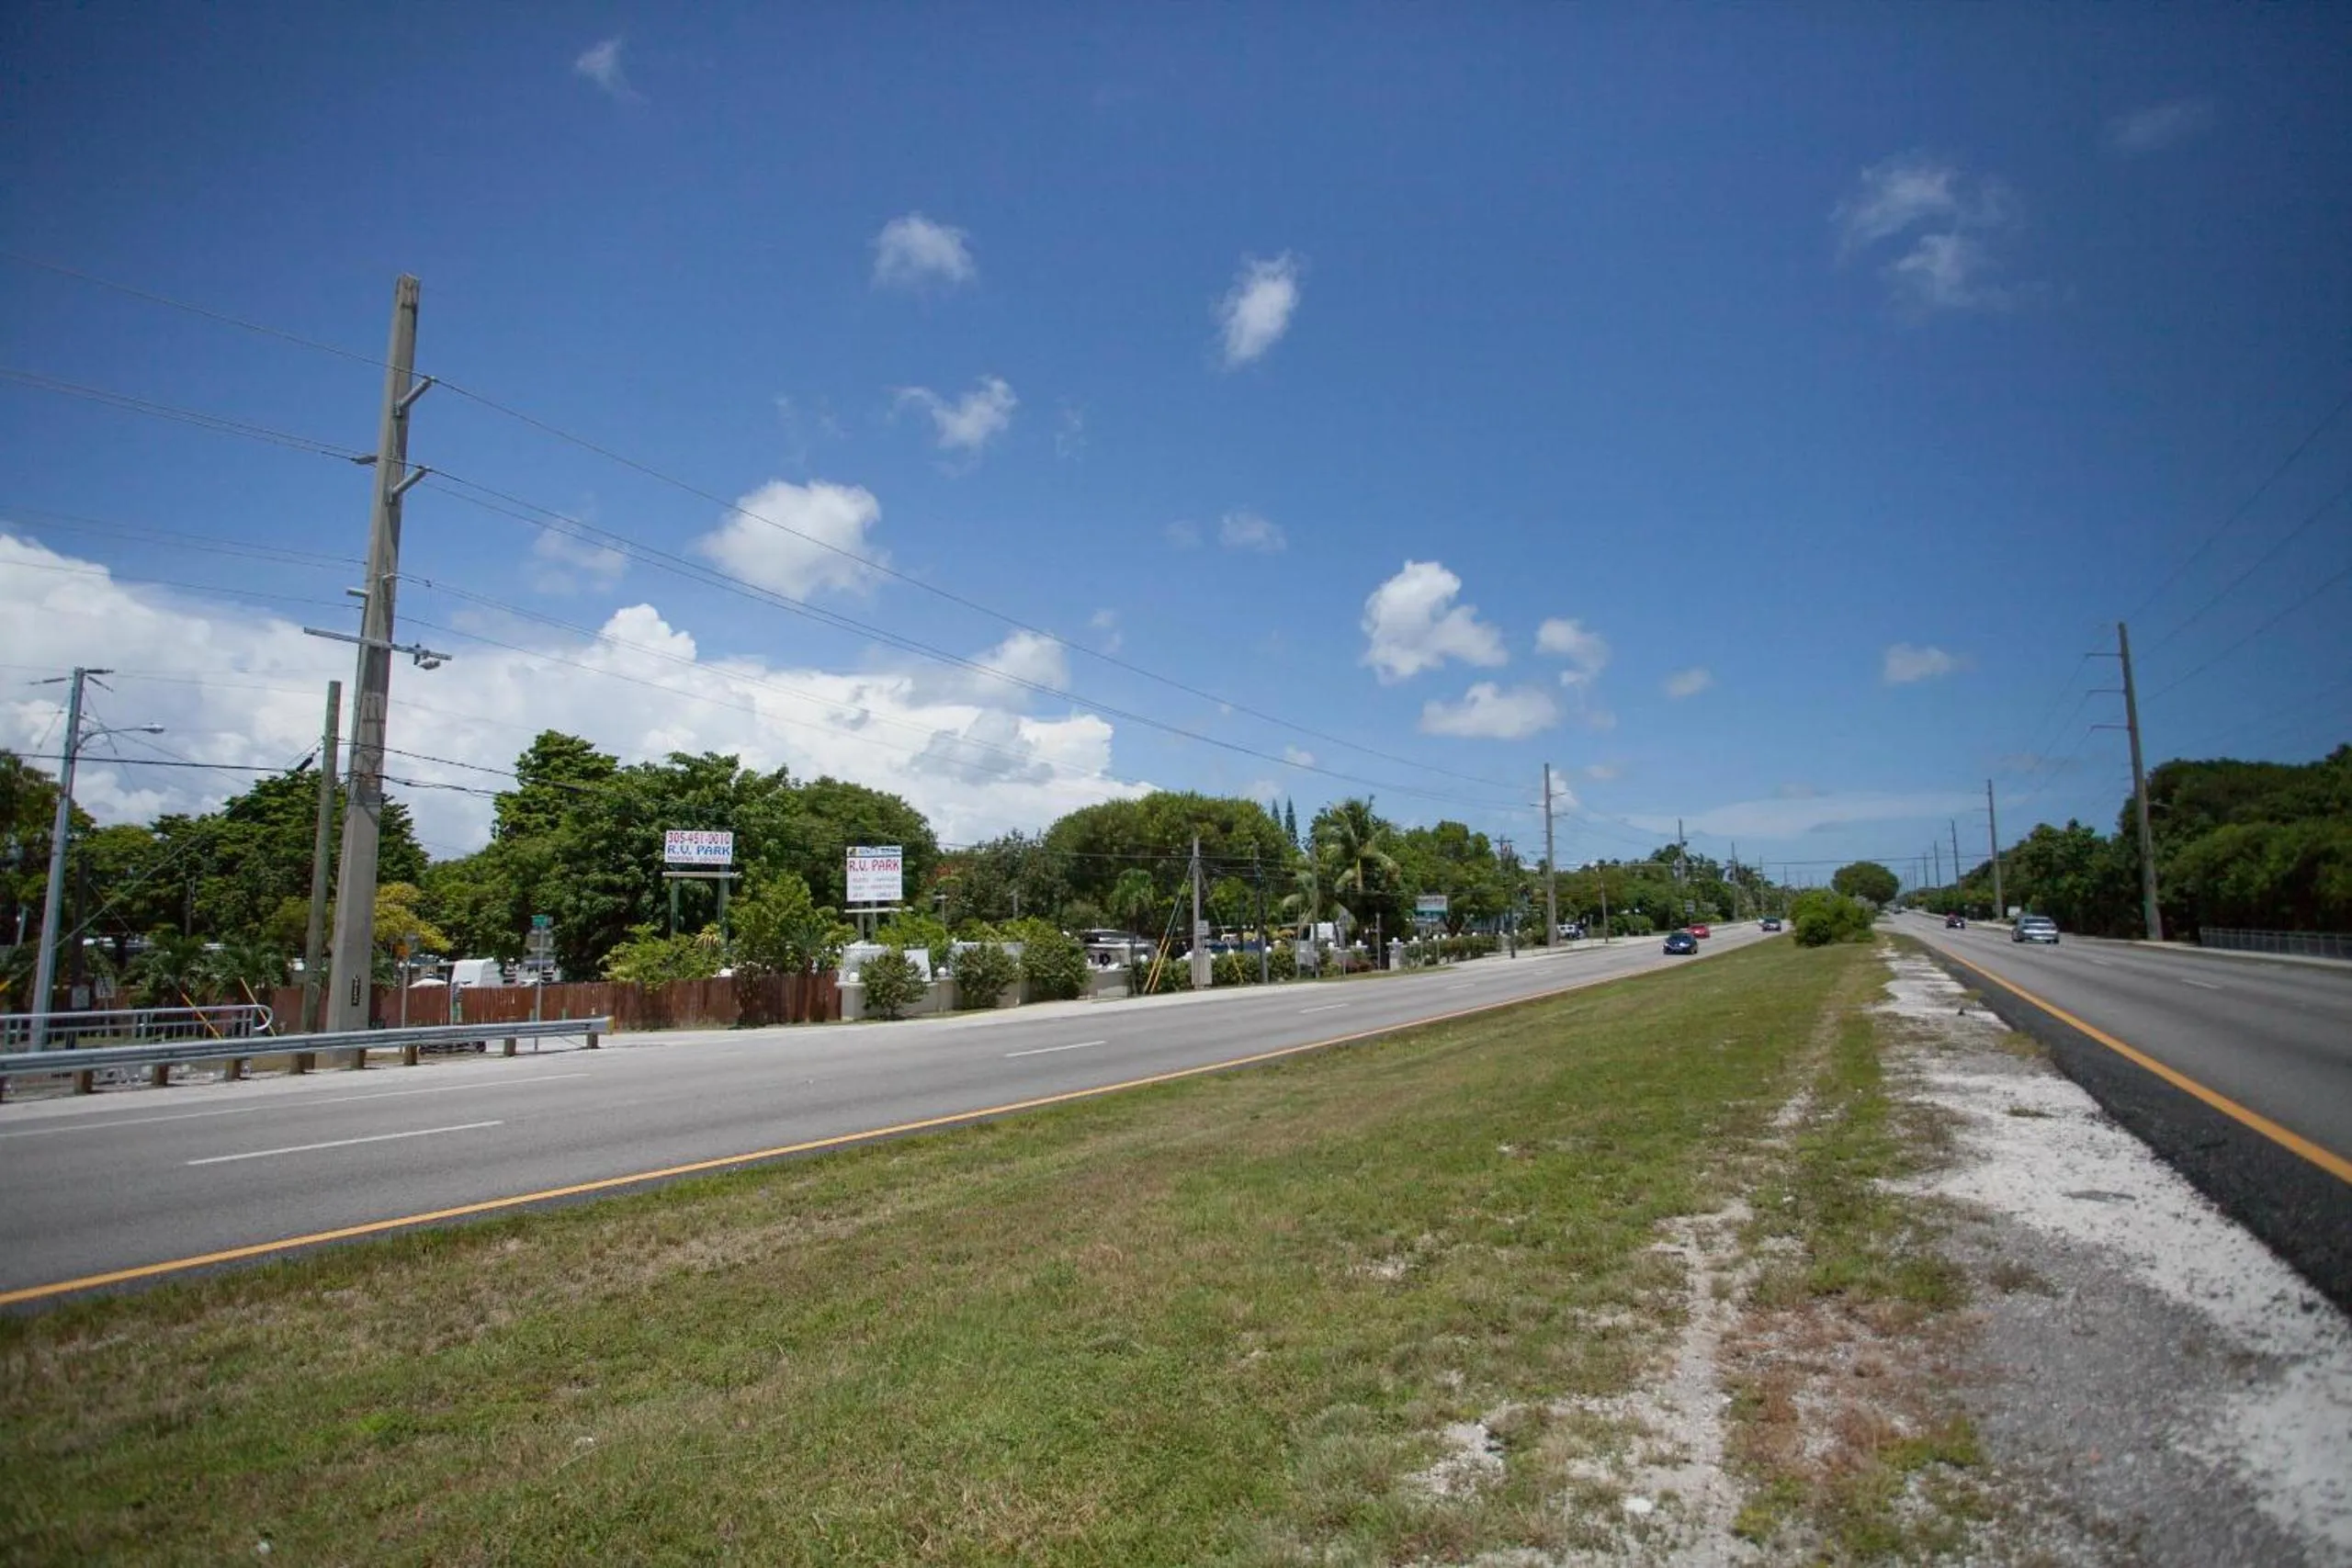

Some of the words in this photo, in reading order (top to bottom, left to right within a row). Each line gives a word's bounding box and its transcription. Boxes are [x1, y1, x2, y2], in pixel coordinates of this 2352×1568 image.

[668, 831, 731, 845] 305-451-0010
[667, 844, 692, 855] R.V.
[696, 845, 730, 856] PARK
[849, 860, 868, 872] R.V.
[872, 859, 899, 872] PARK
